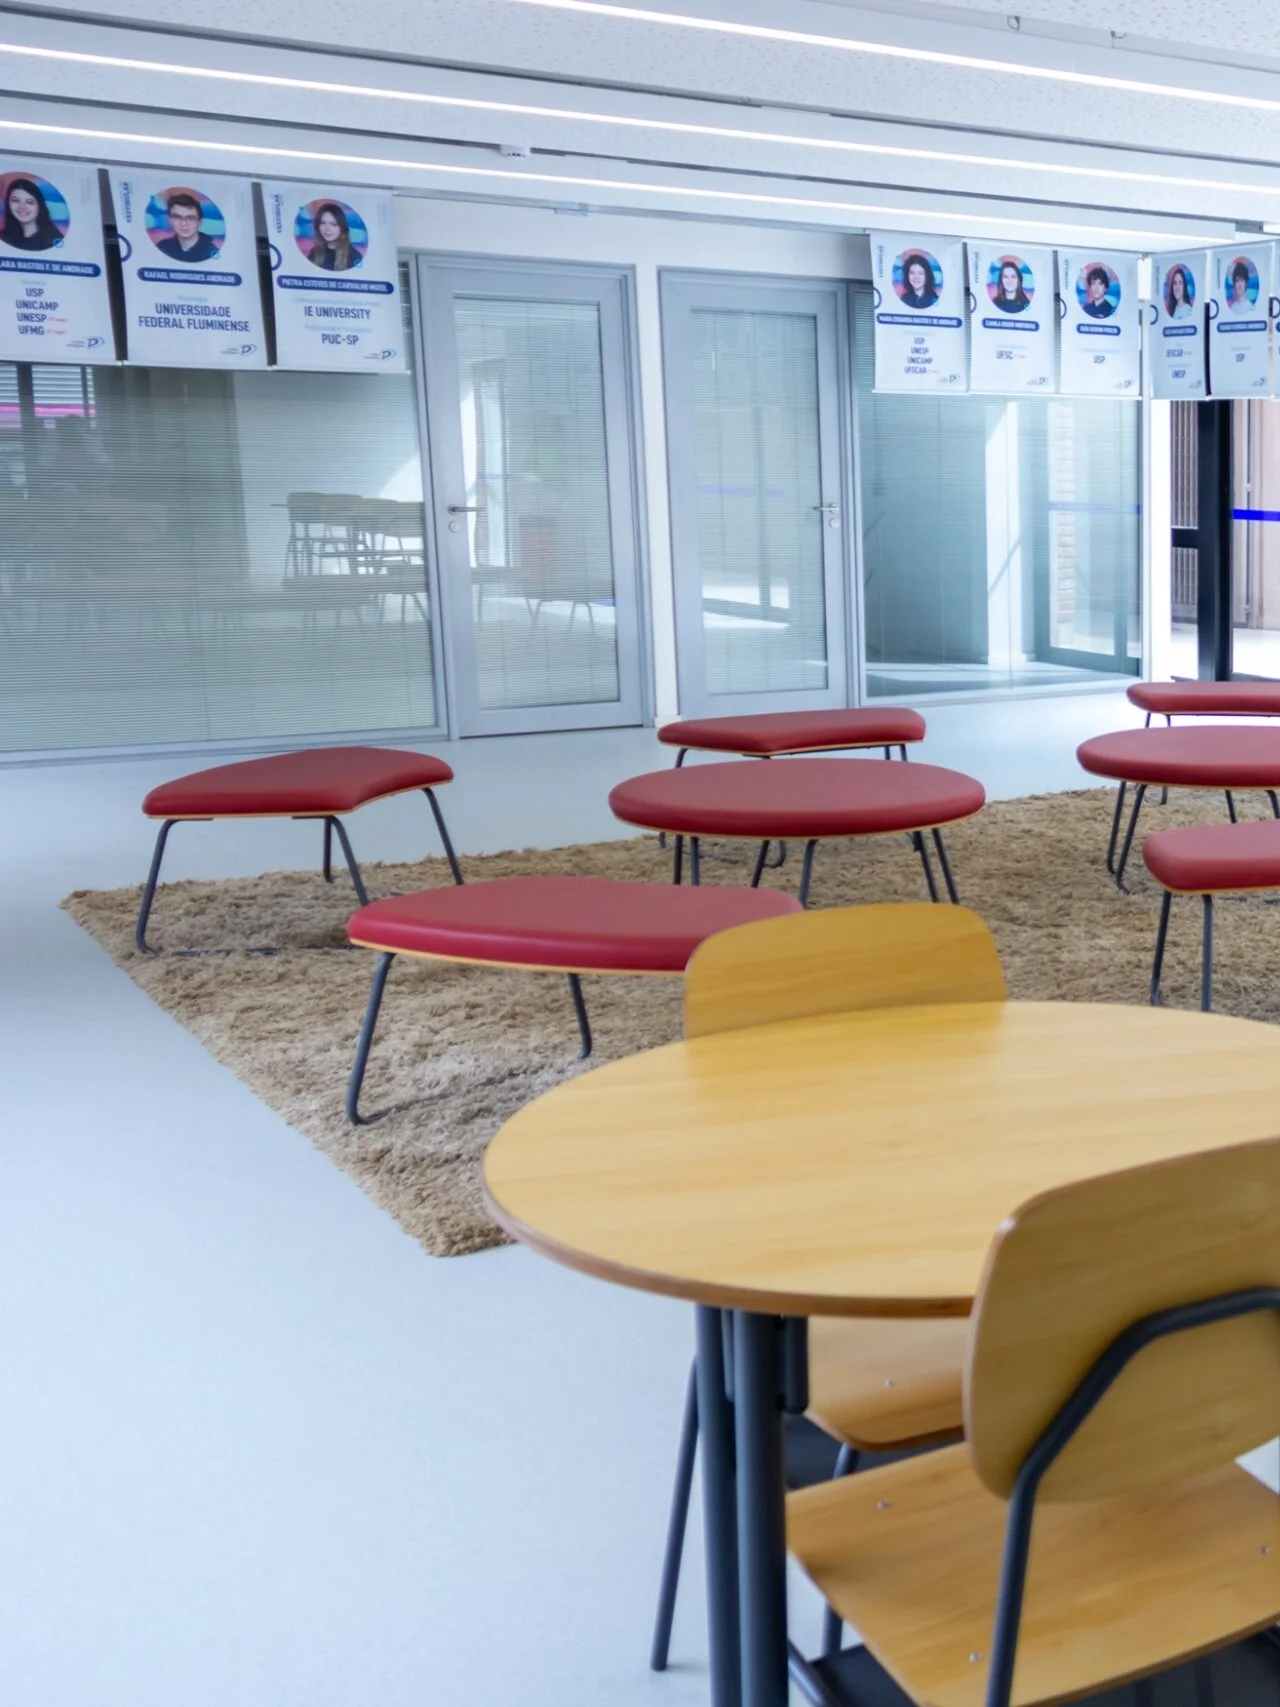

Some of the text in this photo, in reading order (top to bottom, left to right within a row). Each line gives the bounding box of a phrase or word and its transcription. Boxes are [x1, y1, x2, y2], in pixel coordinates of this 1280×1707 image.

[62, 265, 94, 274] ANDRADE
[143, 270, 169, 280] RAFAEL
[206, 274, 236, 284] ANDRADE
[25, 287, 44, 298] USP
[16, 300, 59, 311] UNICAMP
[155, 302, 231, 318] UNIVERSIDADE
[17, 312, 47, 323] UNESP
[304, 305, 371, 319] IE UNIVERSITY
[138, 315, 250, 332] FEDERAL FLUMINENSE
[18, 325, 45, 336] UFMG
[321, 333, 359, 346] PUC-SP
[913, 336, 926, 345] USP
[996, 350, 1013, 360] UFSC
[1093, 355, 1106, 364] USP
